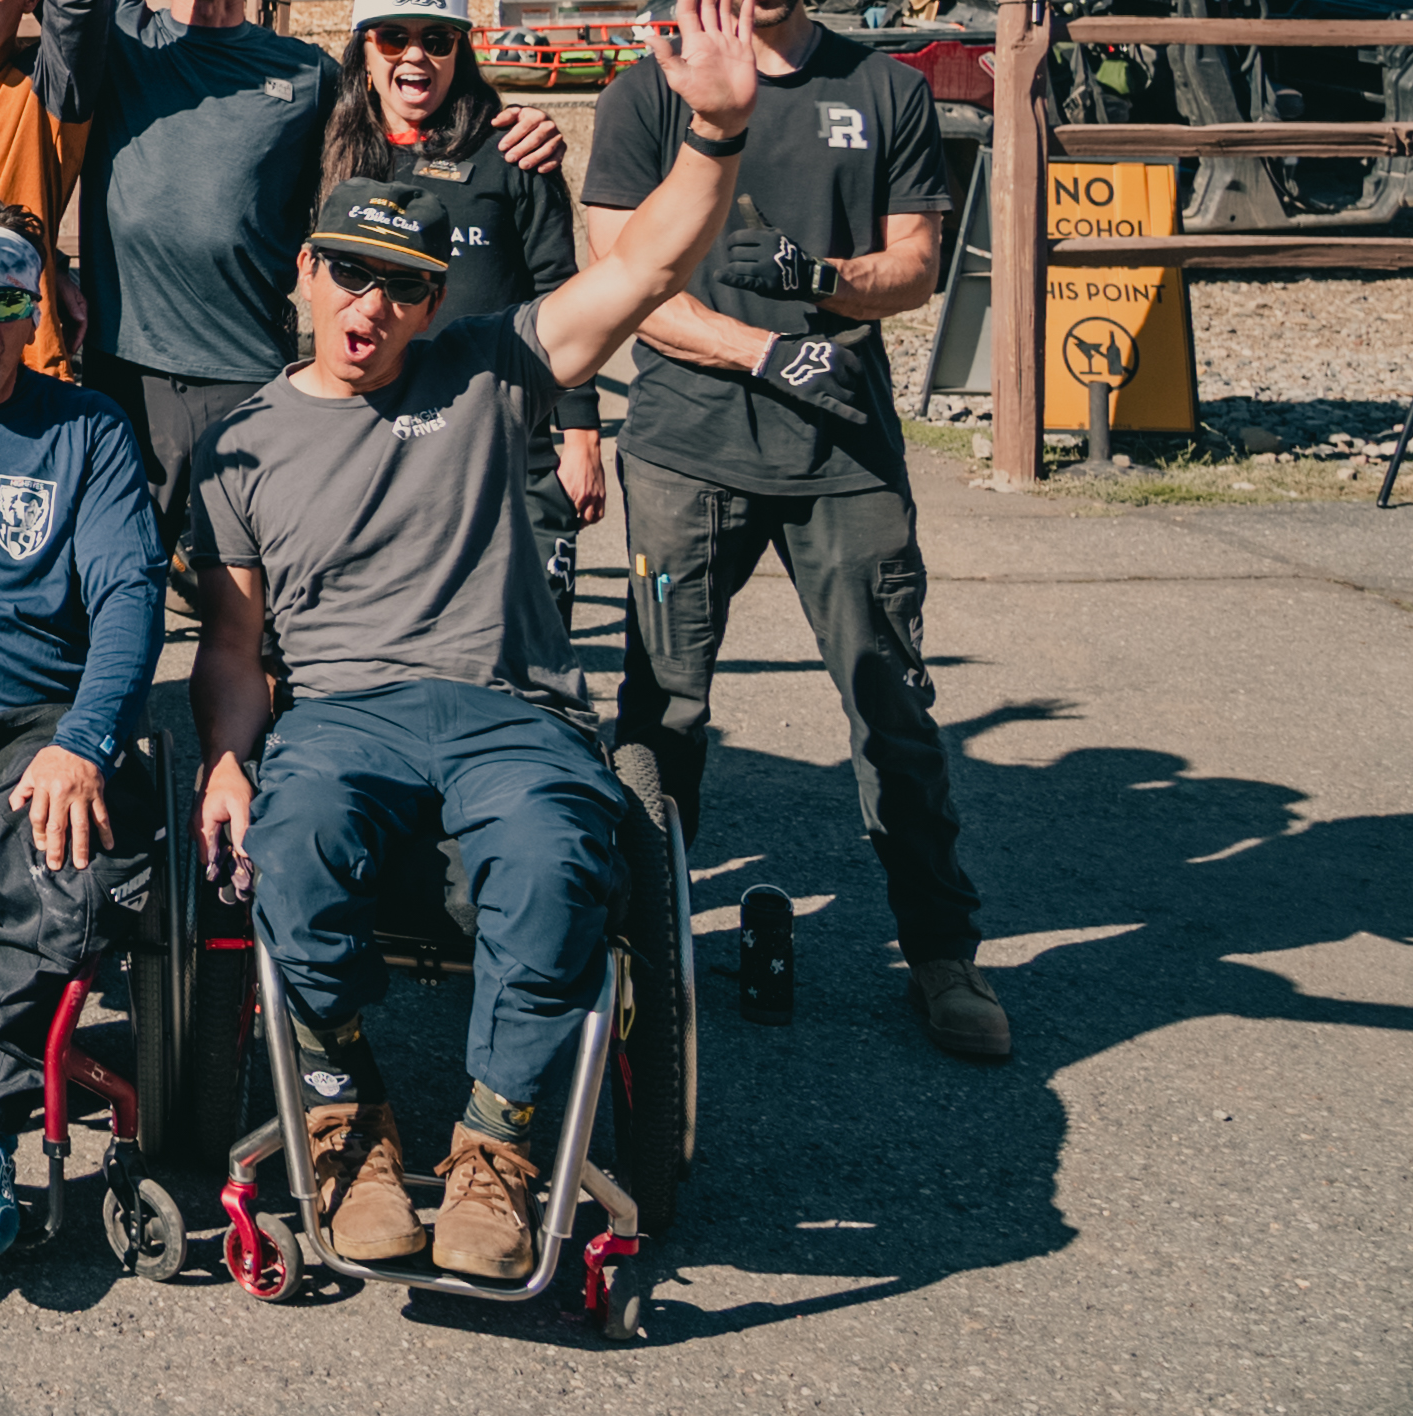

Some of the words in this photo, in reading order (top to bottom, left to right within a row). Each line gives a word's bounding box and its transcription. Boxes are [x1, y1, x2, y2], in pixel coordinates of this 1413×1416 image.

[1054, 176, 1114, 207] NO
[348, 205, 391, 225] E-Bike
[391, 216, 420, 232] Club
[1047, 217, 1143, 237] COHOL
[1047, 281, 1079, 300] HIS
[1086, 282, 1166, 303] POINT
[412, 416, 447, 437] FIVES
